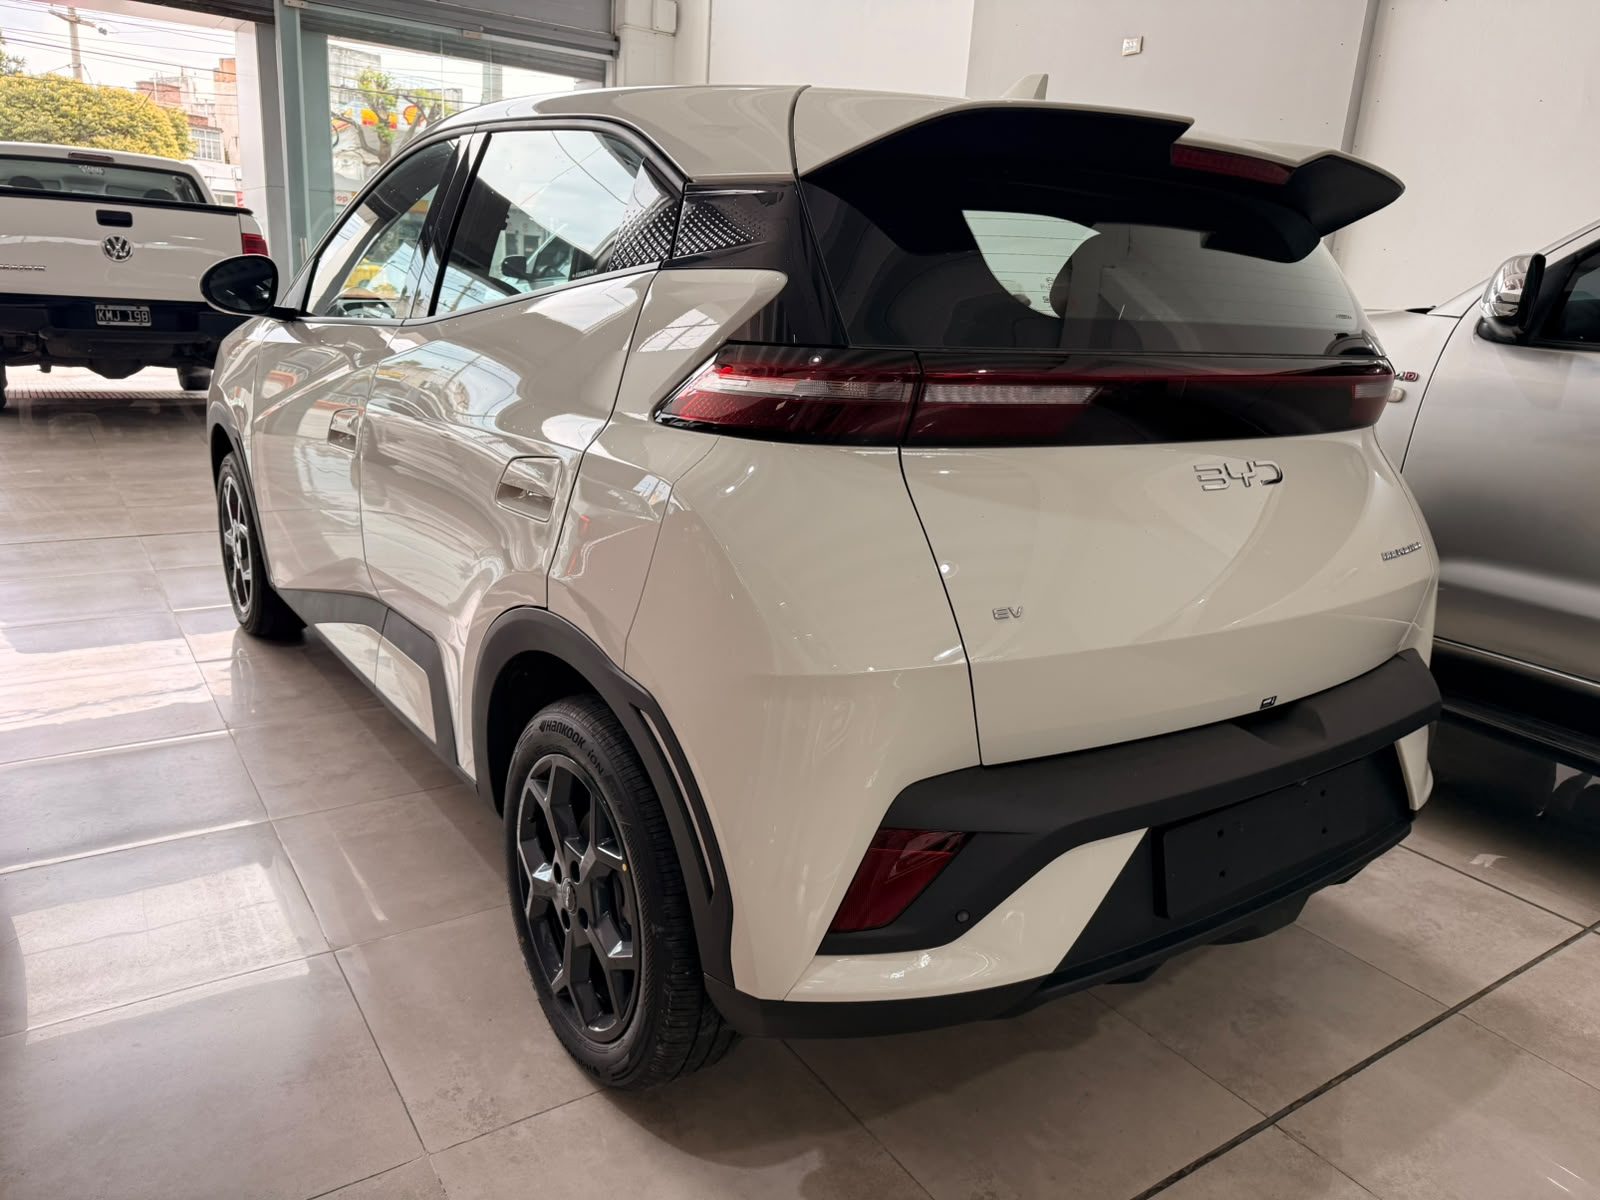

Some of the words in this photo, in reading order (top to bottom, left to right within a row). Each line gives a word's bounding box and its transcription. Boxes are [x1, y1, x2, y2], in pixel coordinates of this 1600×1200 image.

[98, 310, 120, 321] KMJ
[127, 310, 149, 322] 198
[1193, 460, 1284, 492] BYD
[992, 606, 1022, 620] EV
